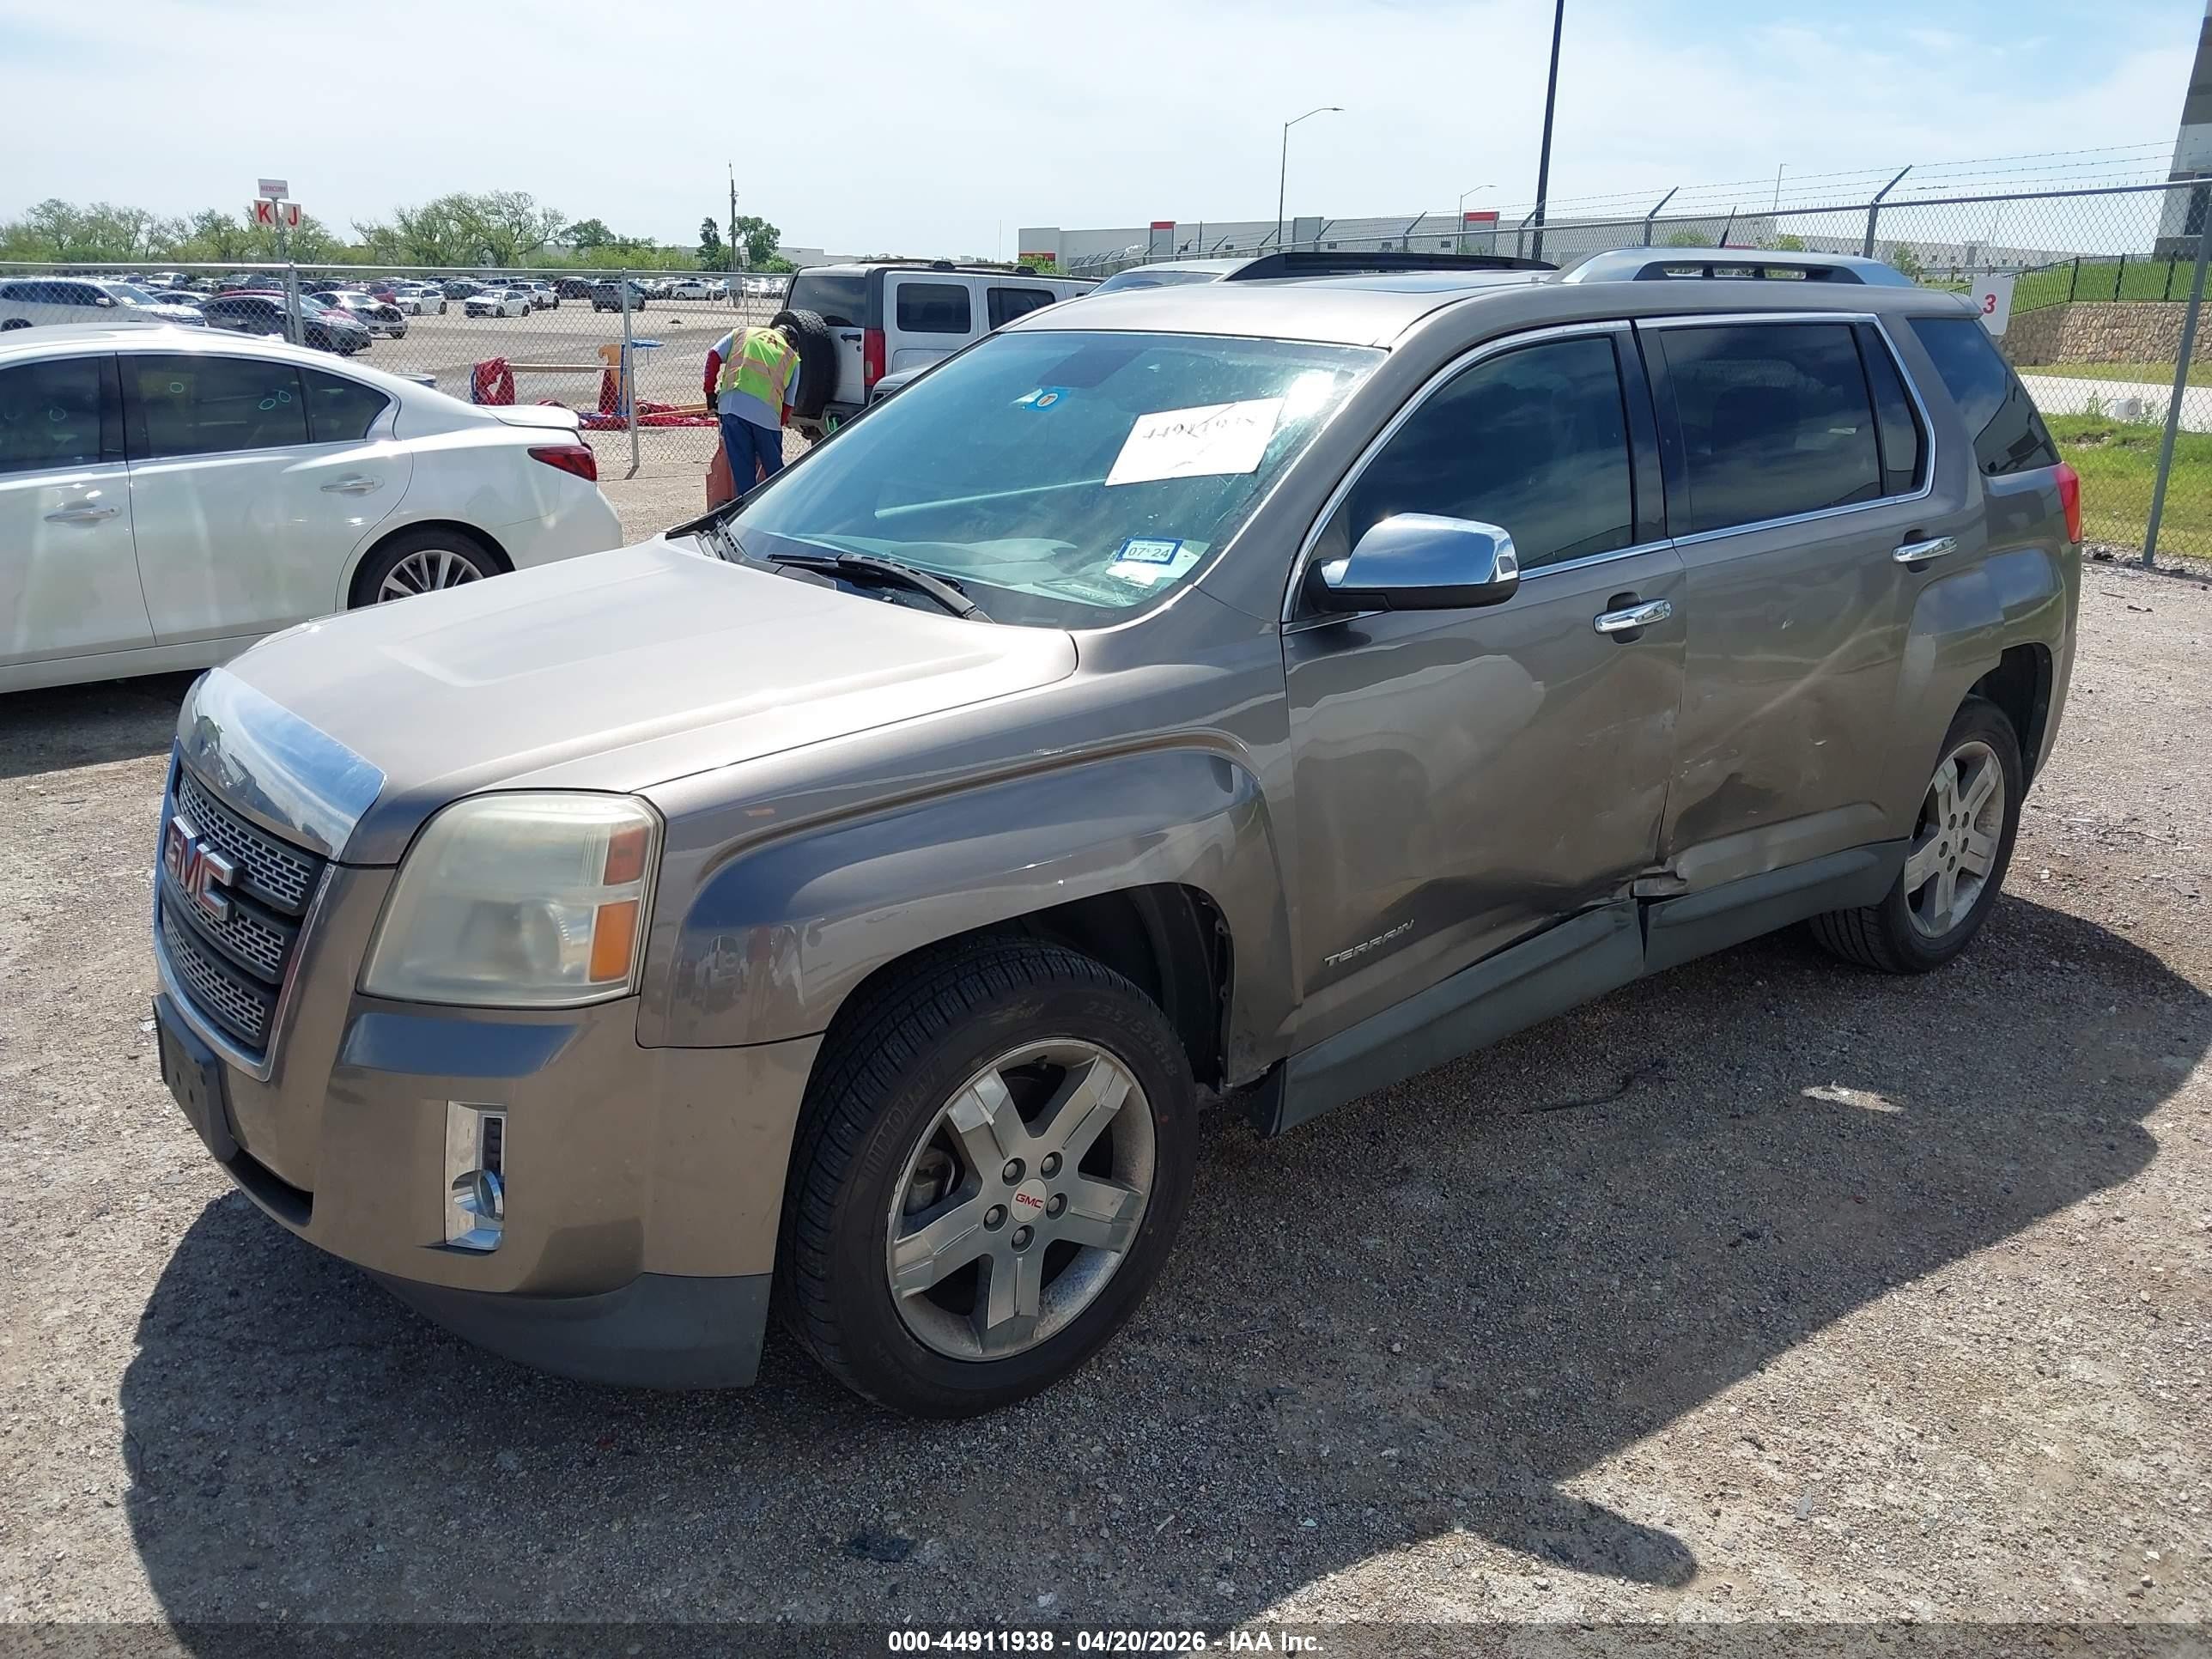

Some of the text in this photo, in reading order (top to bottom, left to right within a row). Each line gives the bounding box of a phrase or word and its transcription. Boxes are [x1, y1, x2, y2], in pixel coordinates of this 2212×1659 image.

[258, 203, 272, 223] K
[288, 206, 297, 226] J
[1983, 294, 1996, 314] 3
[1128, 547, 1170, 558] 07 24
[164, 815, 234, 922] GMC
[1323, 918, 1414, 967] TERRAIN
[1015, 1193, 1045, 1209] GMC
